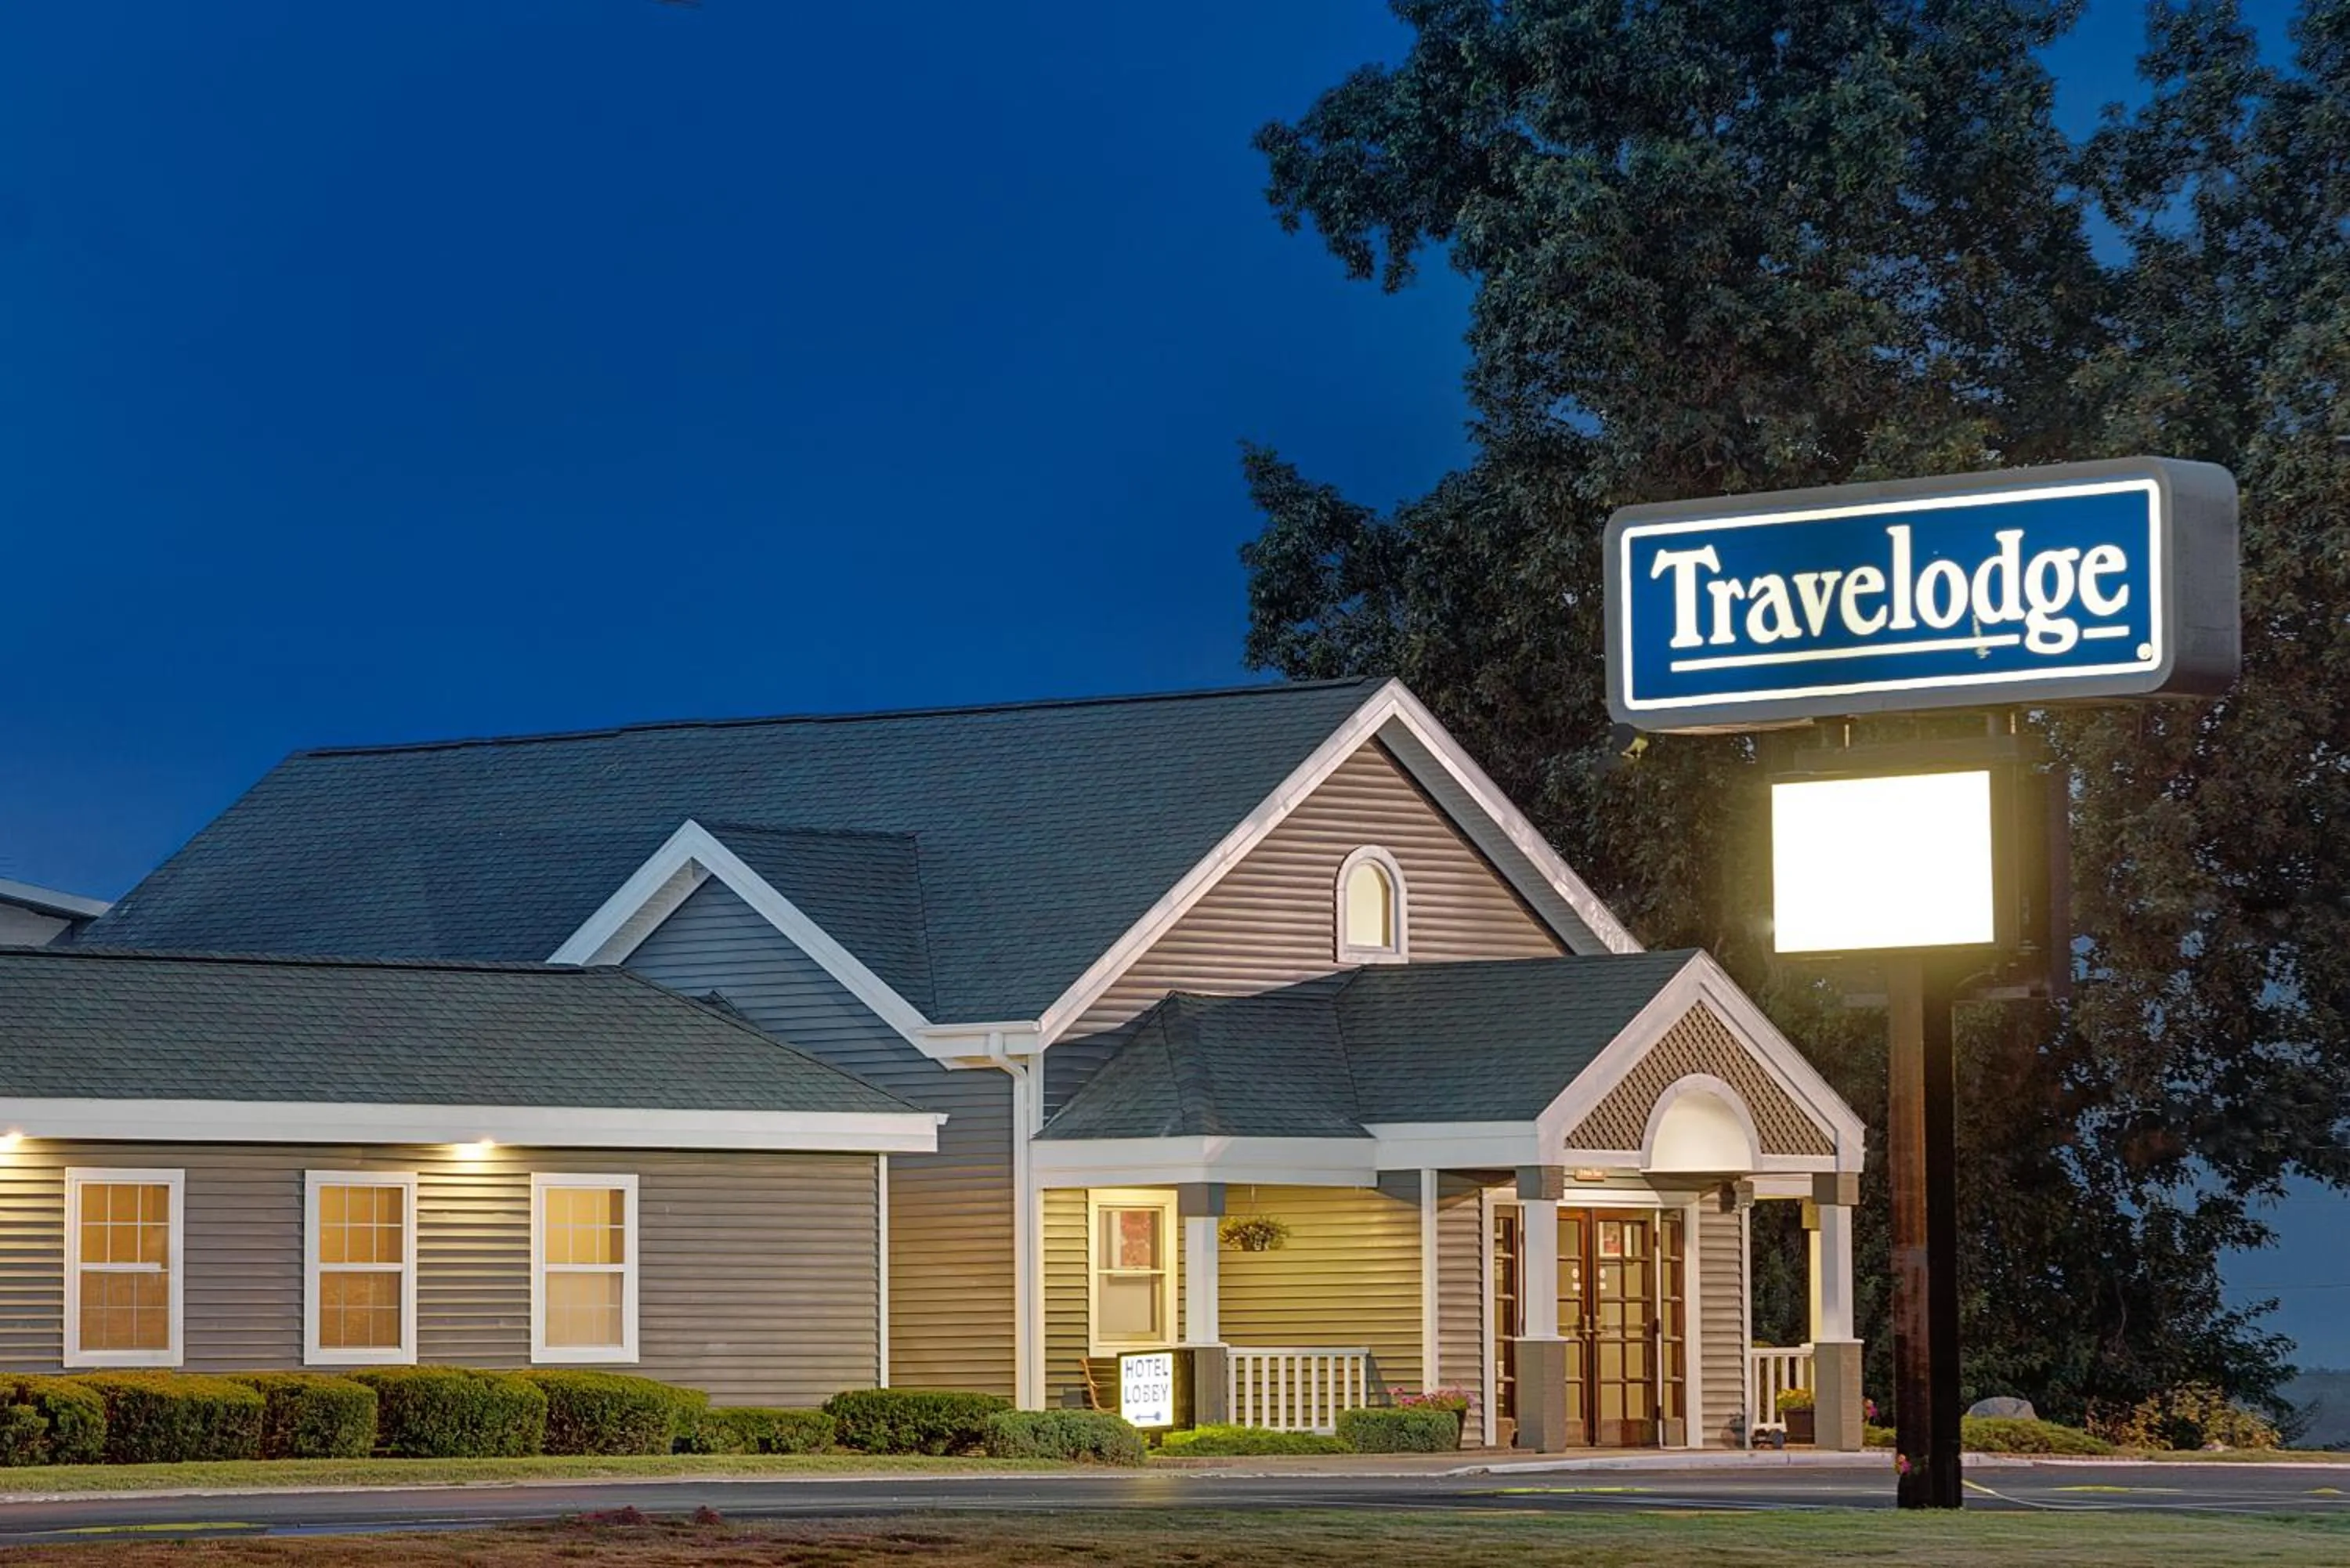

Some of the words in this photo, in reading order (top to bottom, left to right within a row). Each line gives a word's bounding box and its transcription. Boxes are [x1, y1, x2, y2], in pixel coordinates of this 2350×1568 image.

[1650, 525, 2130, 654] Travelodge
[1125, 1358, 1169, 1378] HOTEL
[1124, 1383, 1169, 1404] LOBBY
